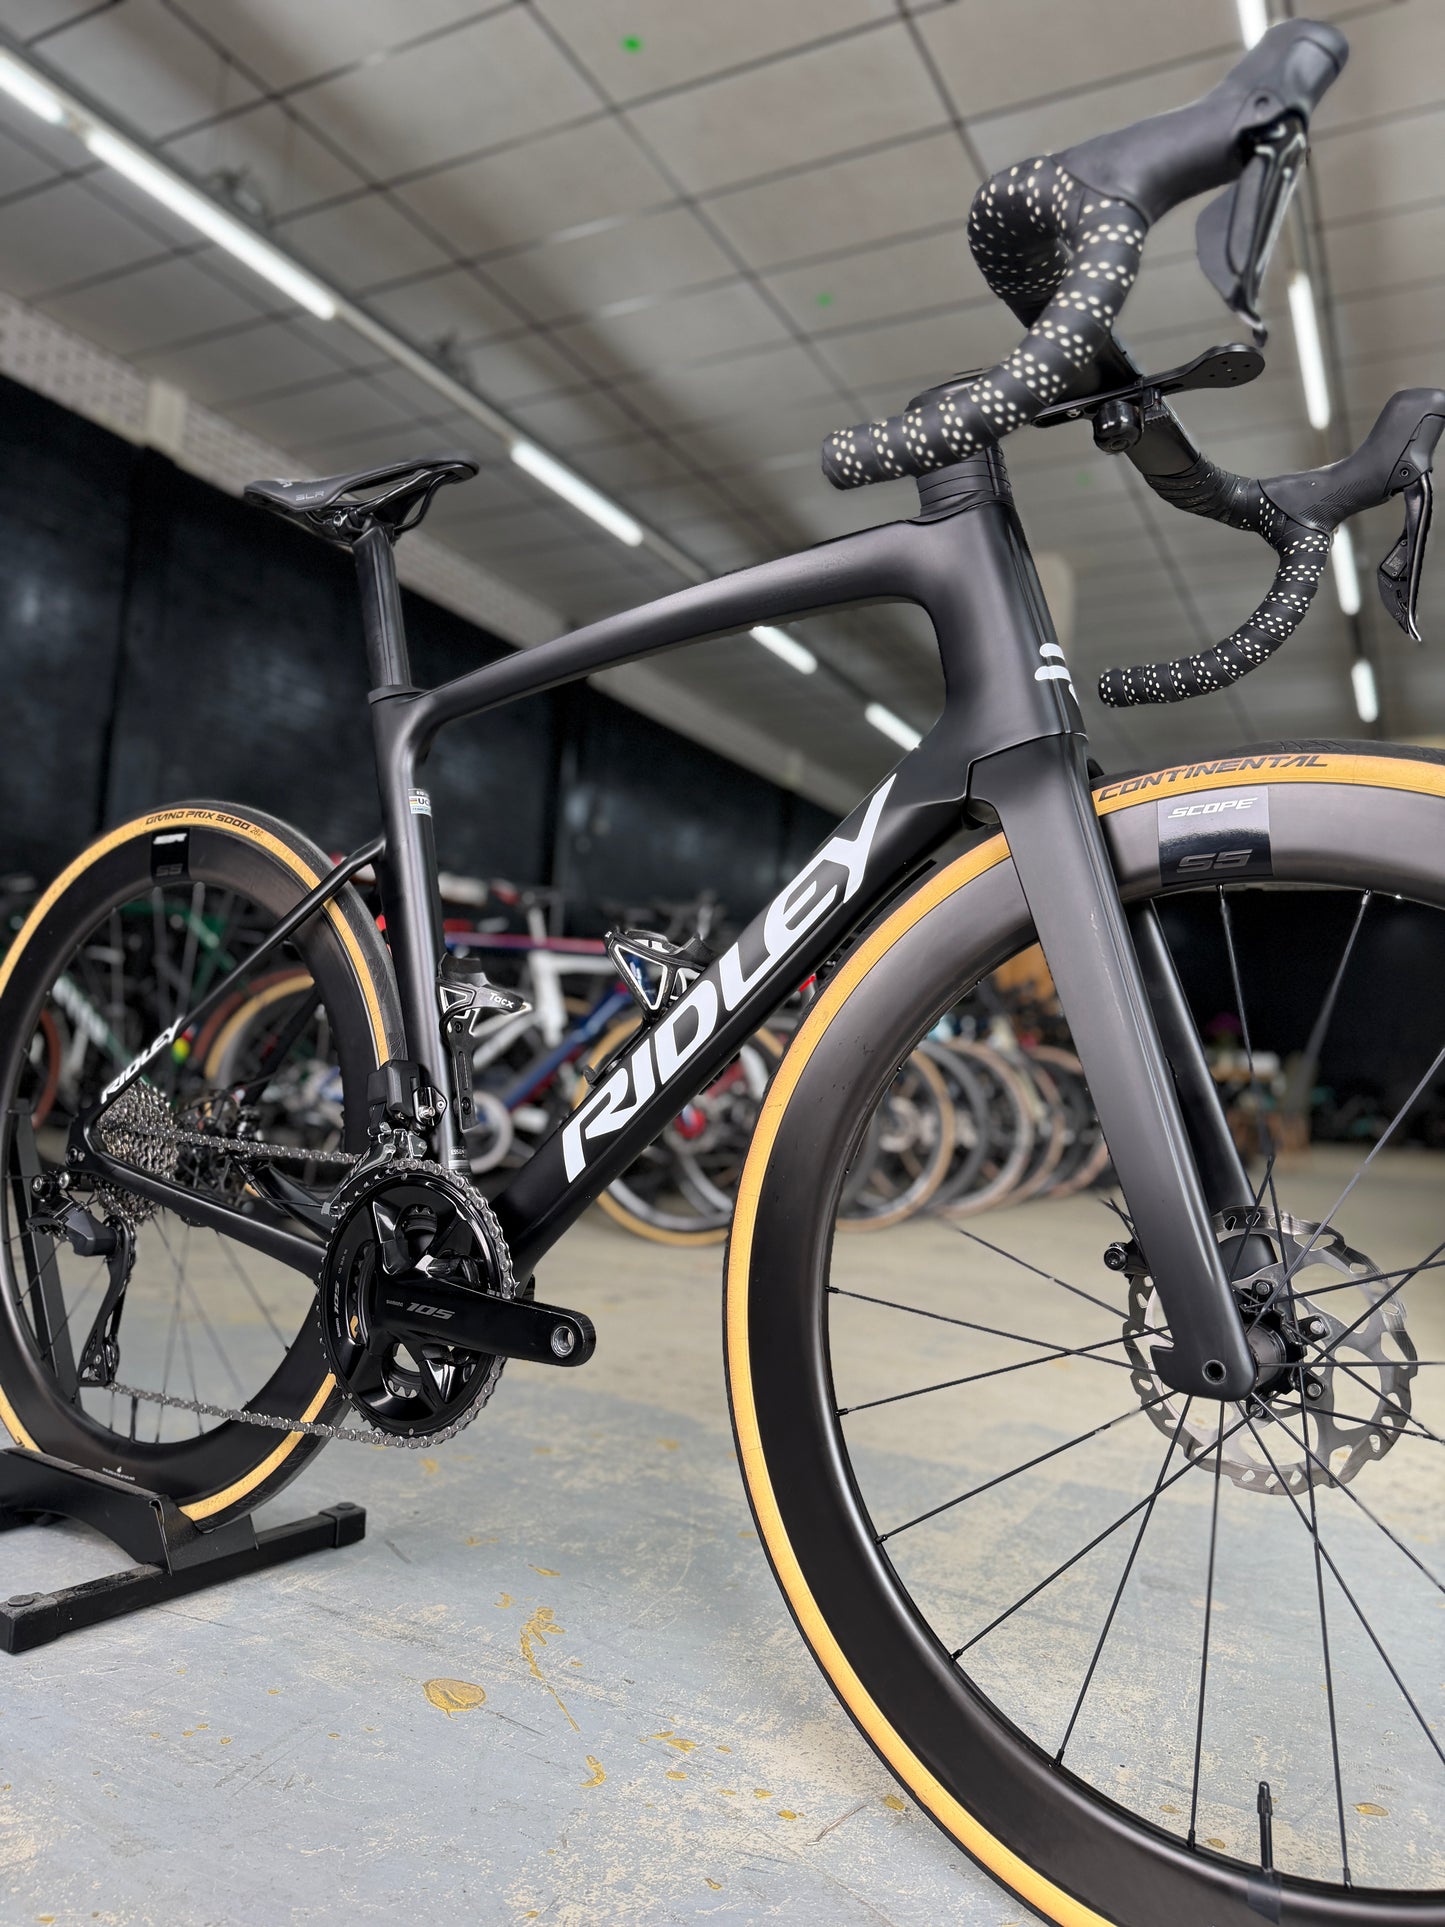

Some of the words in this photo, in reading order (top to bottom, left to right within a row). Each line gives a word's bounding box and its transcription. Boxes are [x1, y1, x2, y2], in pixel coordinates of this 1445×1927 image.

[295, 491, 325, 501] SLR
[1097, 754, 1328, 802] CONTINENTAL
[1167, 797, 1258, 819] SCOPE
[146, 811, 184, 825] GRAND
[185, 810, 215, 820] PRIX
[216, 814, 251, 830] 5000
[562, 773, 897, 1183] RIDLEY
[490, 992, 515, 1008] Tacx
[101, 1016, 185, 1104] RIDLEY
[406, 1302, 456, 1320] 105
